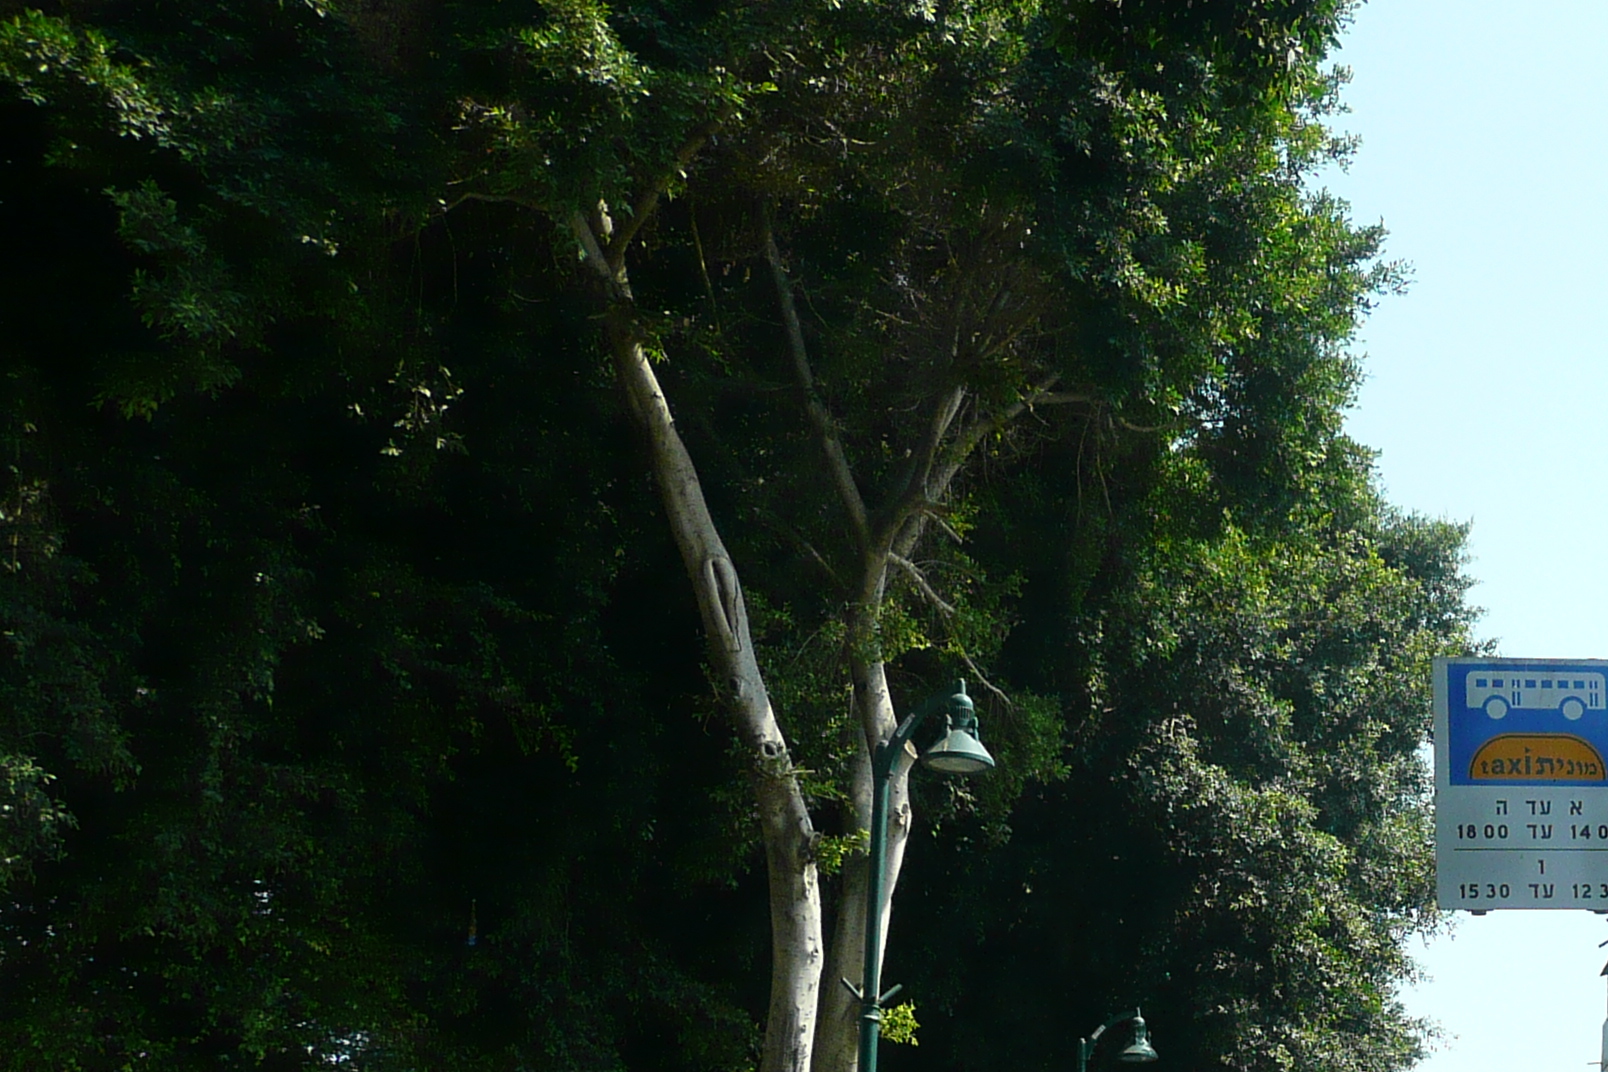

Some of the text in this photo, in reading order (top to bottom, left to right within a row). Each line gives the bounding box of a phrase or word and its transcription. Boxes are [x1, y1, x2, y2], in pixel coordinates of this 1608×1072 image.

[1481, 747, 1531, 775] taxi
[1536, 757, 1598, 775] מונית
[1496, 800, 1582, 815] א עד ה
[1526, 824, 1552, 840] עד
[1528, 883, 1554, 899] עד
